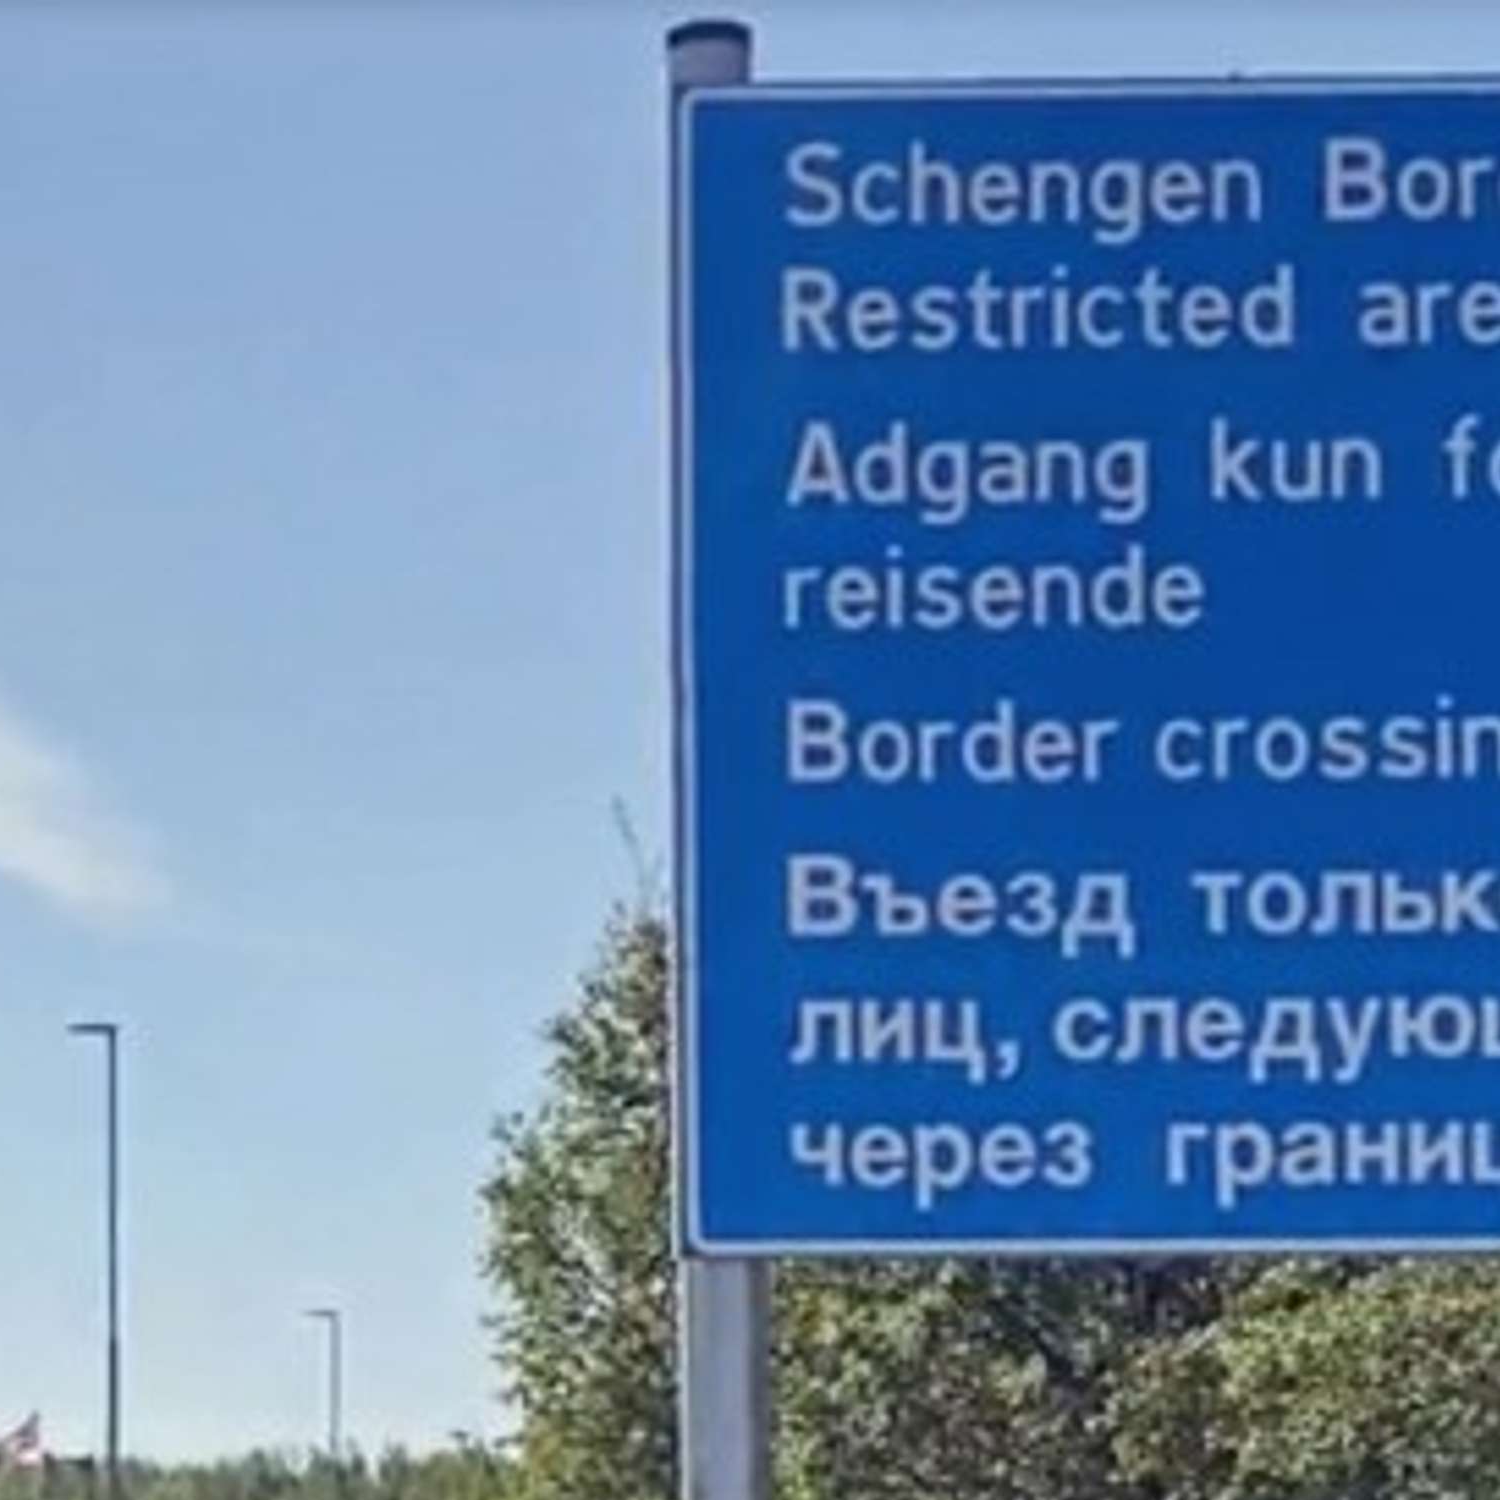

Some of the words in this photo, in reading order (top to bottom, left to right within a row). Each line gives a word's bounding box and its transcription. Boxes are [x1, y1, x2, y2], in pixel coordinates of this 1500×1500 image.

[785, 139, 1263, 245] Schengen
[781, 264, 1295, 351] Restricted
[1358, 280, 1500, 346] are
[787, 420, 1149, 526] Adgang
[1210, 417, 1381, 501] kun
[1443, 414, 1500, 499] f
[784, 544, 1205, 631] reisende
[786, 698, 1119, 783] Border
[1155, 695, 1500, 780] crossin
[786, 853, 1137, 959] Въезд
[1191, 869, 1500, 936] тольк
[789, 997, 1021, 1084] лиц,
[1052, 994, 1500, 1084] следую
[789, 1119, 1094, 1211] через
